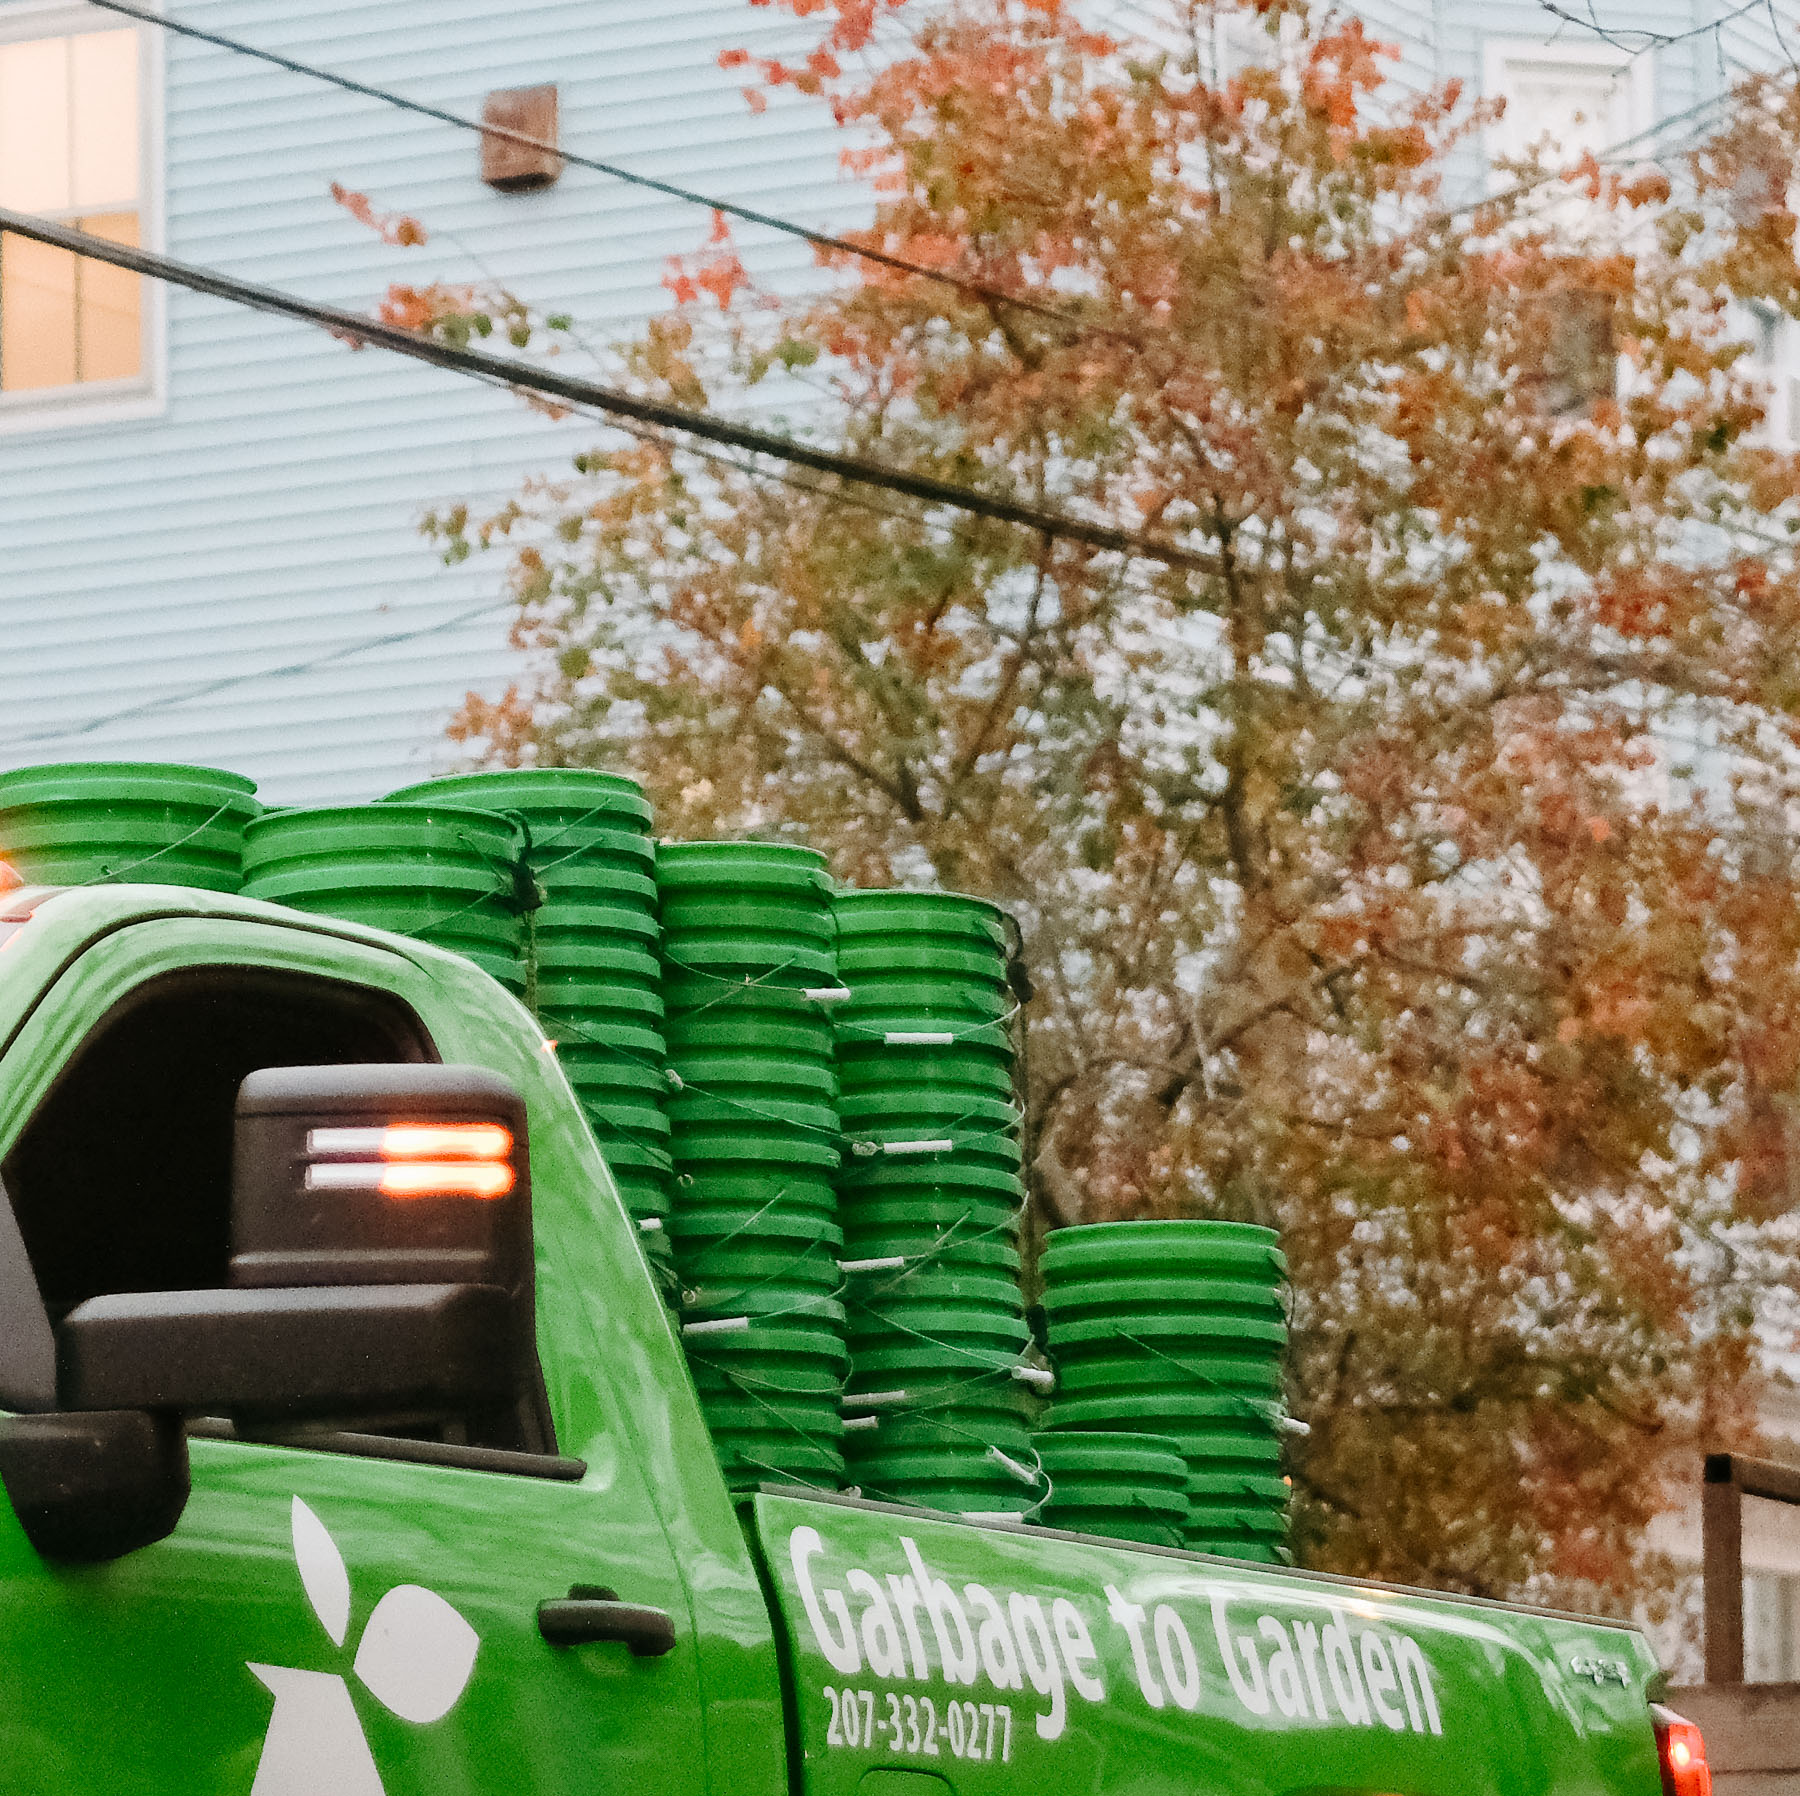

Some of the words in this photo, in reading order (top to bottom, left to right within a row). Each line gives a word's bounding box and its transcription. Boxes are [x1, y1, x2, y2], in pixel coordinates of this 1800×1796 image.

[789, 1525, 1107, 1740] Garbage
[1103, 1585, 1197, 1711] to
[1204, 1584, 1444, 1735] Garden
[823, 1685, 1012, 1764] 207-332-0277
